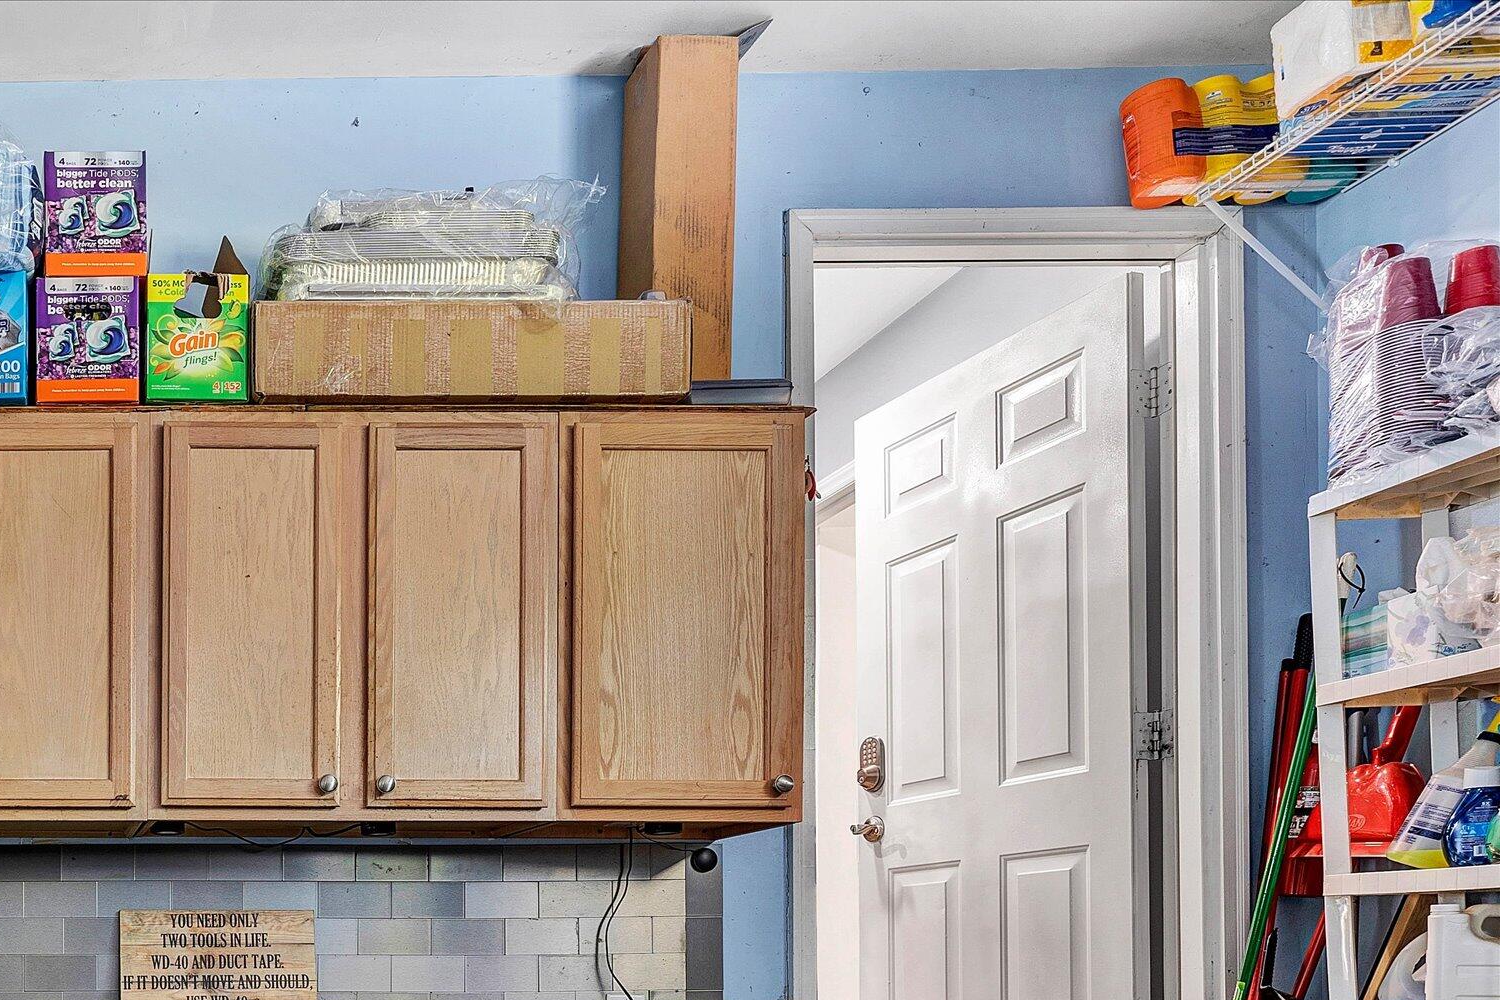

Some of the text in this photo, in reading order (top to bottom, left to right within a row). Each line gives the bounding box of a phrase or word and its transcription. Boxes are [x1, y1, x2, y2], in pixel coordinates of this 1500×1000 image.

[58, 157, 65, 165] 4
[84, 158, 97, 166] 72
[56, 169, 108, 179] bigger Tide
[56, 178, 96, 189] better
[152, 279, 170, 287] 50%
[47, 295, 99, 305] bigger Tide
[169, 331, 218, 357] Gain
[183, 351, 217, 368] flings!
[5, 372, 20, 380] Bags
[213, 381, 241, 390] 4 152
[170, 913, 260, 928] YOU NEED ONLY
[160, 932, 272, 948] TWO TOOLS IN LIFE.
[151, 954, 285, 969] WD-40 AND DUCT TAPE.
[123, 974, 313, 992] IF IT DOESN'T MOVE AND SHOULD,
